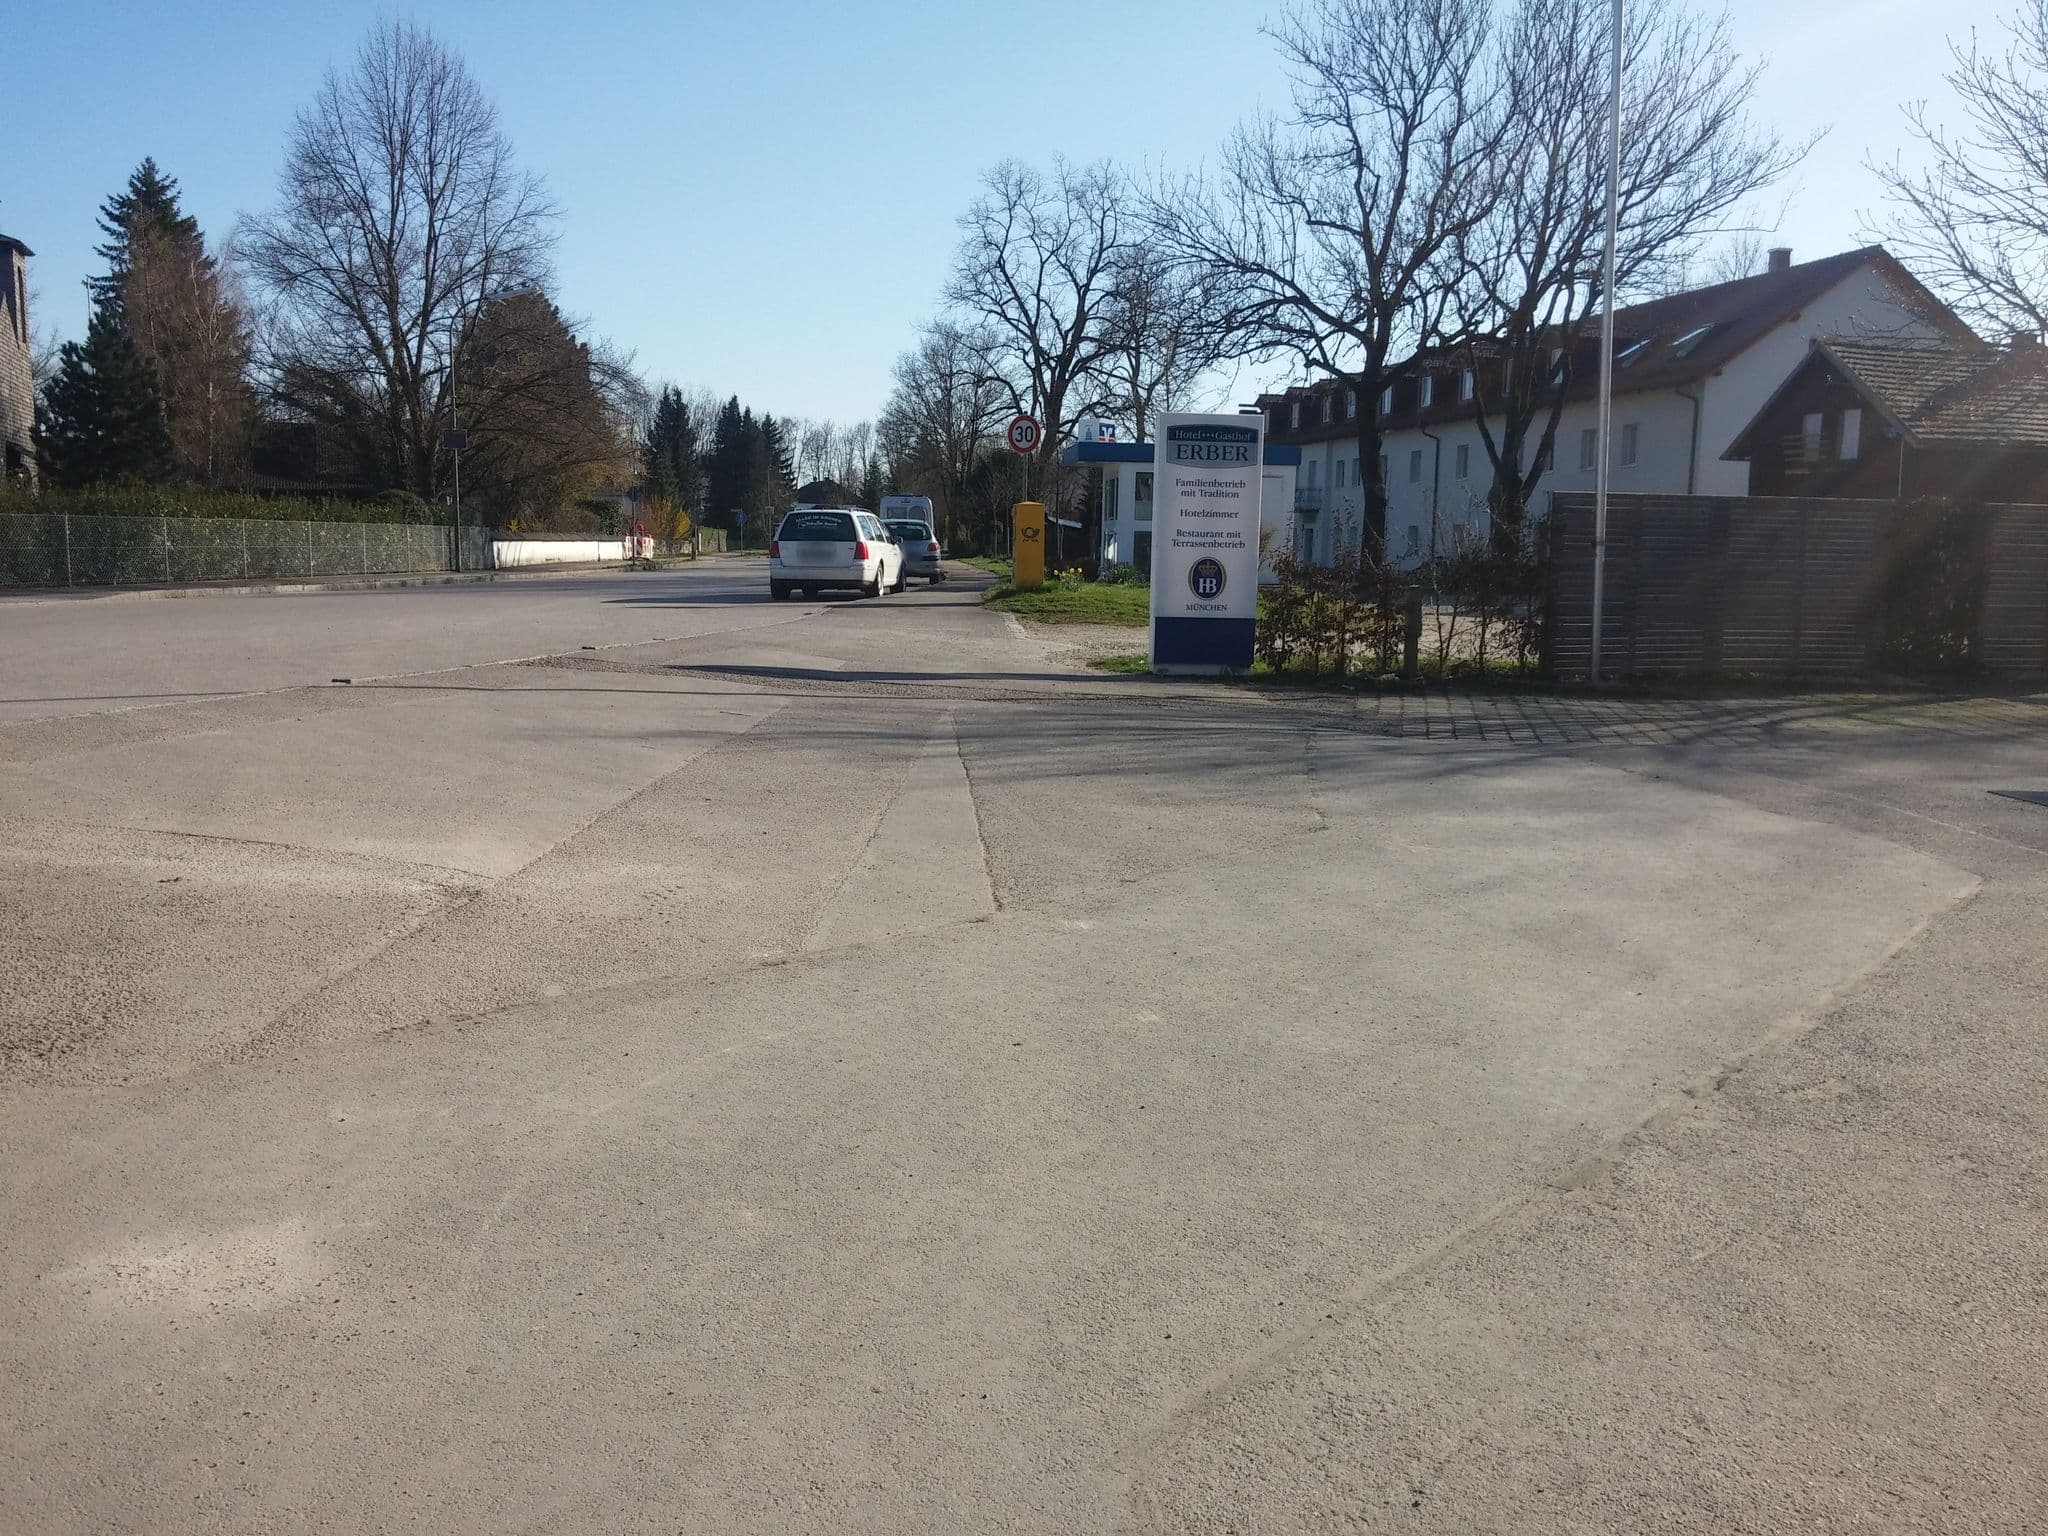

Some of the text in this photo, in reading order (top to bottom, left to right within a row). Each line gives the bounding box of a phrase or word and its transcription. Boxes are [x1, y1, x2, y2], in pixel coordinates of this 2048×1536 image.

[1015, 425, 1034, 443] 30
[1176, 430, 1250, 441] Hotel Gasthof
[1176, 444, 1249, 461] ERBER
[1176, 478, 1246, 489] Familienbetrieb
[1181, 489, 1239, 498] mit Tradition
[1180, 509, 1239, 518] Hotelzimmer
[1176, 529, 1241, 539] Restaurant mit
[1172, 539, 1246, 549] Terrassenbetrieb
[1199, 577, 1217, 593] HB
[1185, 603, 1227, 612] MÜNCHEN
